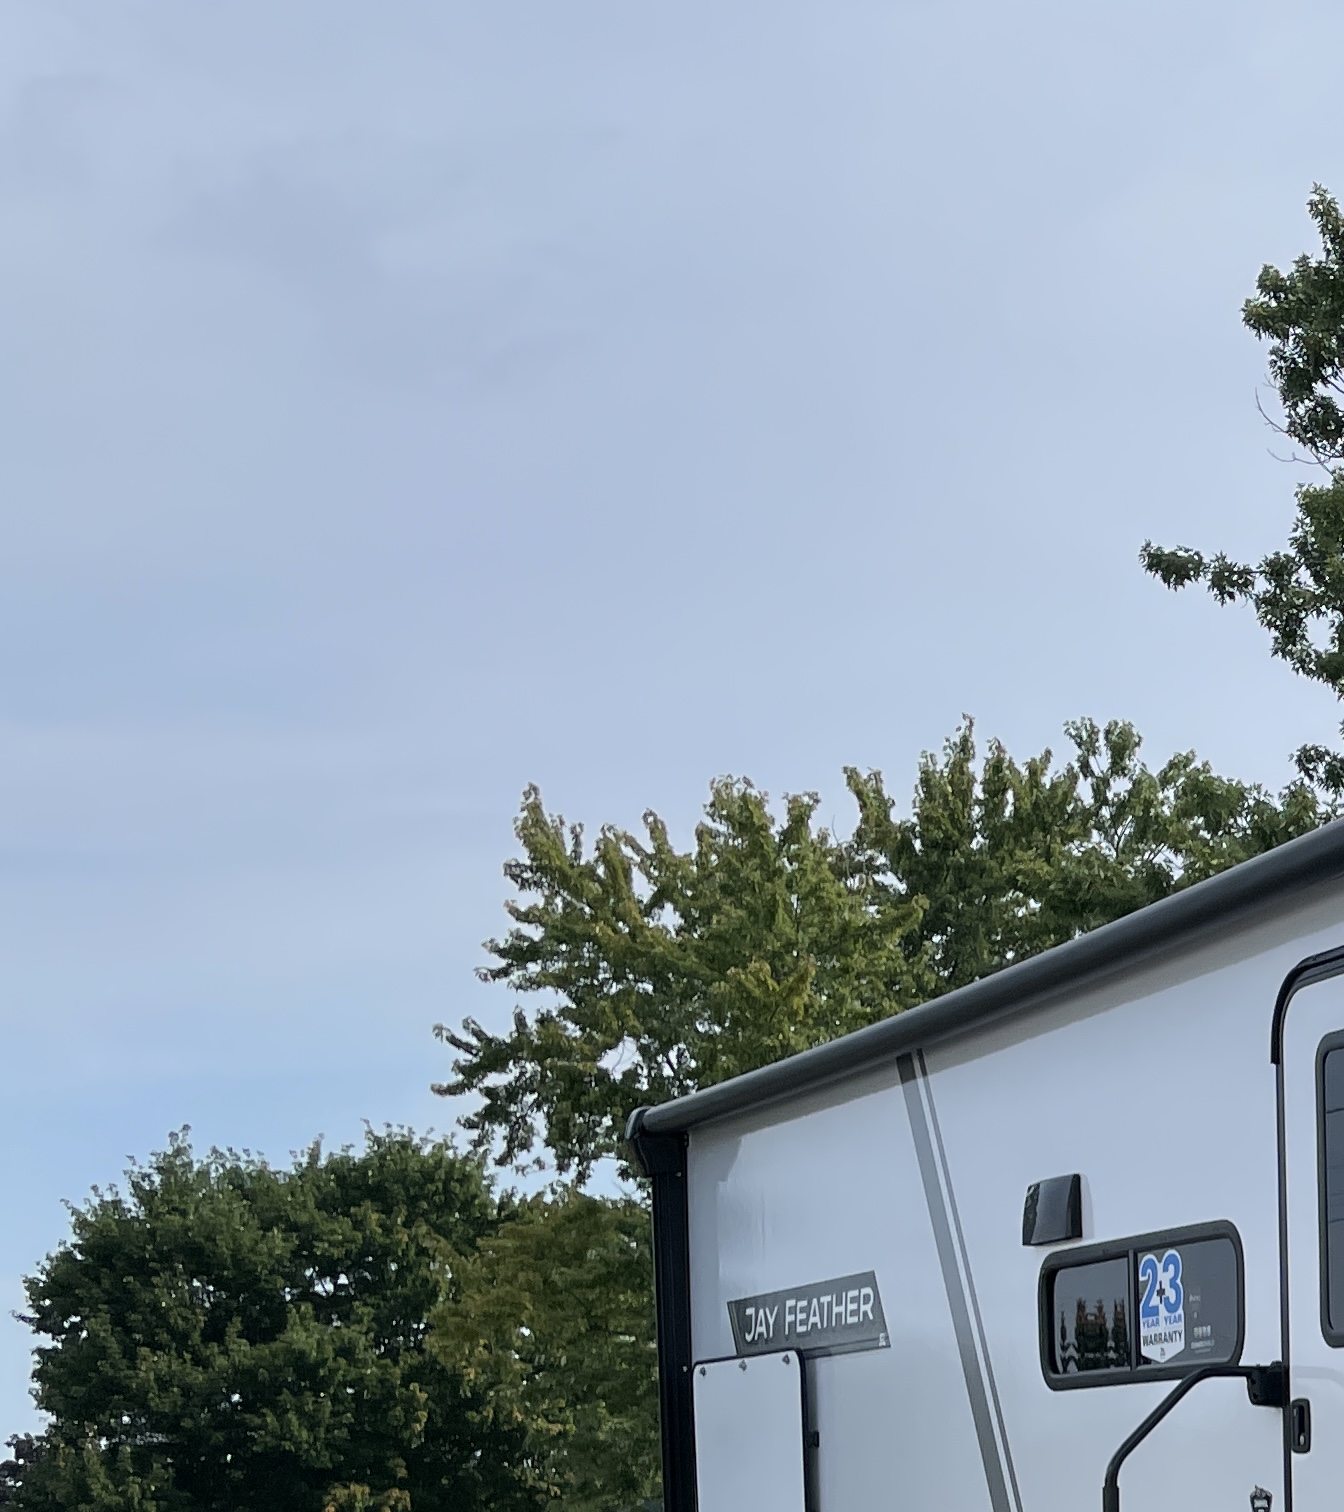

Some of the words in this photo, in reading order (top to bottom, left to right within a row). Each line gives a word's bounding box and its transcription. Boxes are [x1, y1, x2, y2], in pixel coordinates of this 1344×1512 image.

[745, 1305, 778, 1342] JAY
[784, 1286, 874, 1335] FEATHER
[1142, 1318, 1160, 1329] YEAR
[1164, 1314, 1182, 1326] YEAR
[1142, 1330, 1183, 1347] WARRANTY
